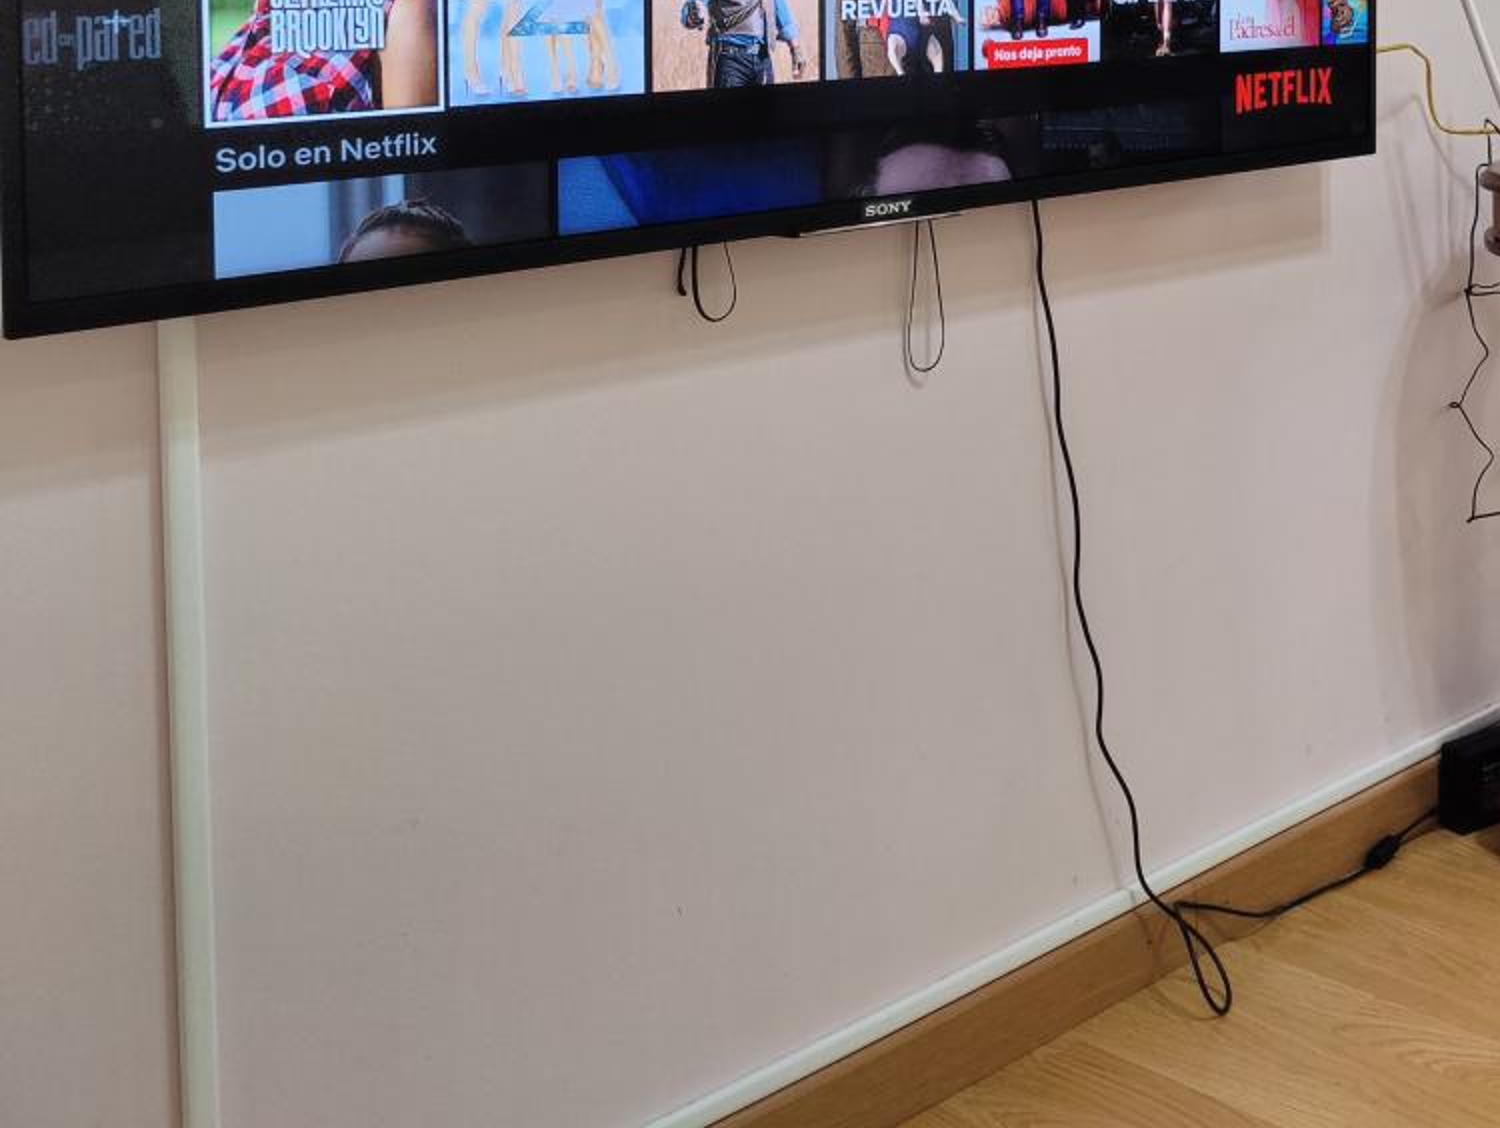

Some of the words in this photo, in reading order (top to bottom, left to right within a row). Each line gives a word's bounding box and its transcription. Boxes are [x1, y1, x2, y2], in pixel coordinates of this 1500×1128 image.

[271, 7, 385, 58] BROOKLYN
[1235, 67, 1333, 115] NETFLIX
[215, 145, 286, 174] Solo
[294, 144, 331, 166] en
[340, 131, 438, 163] Netflix
[865, 200, 912, 217] SONY
